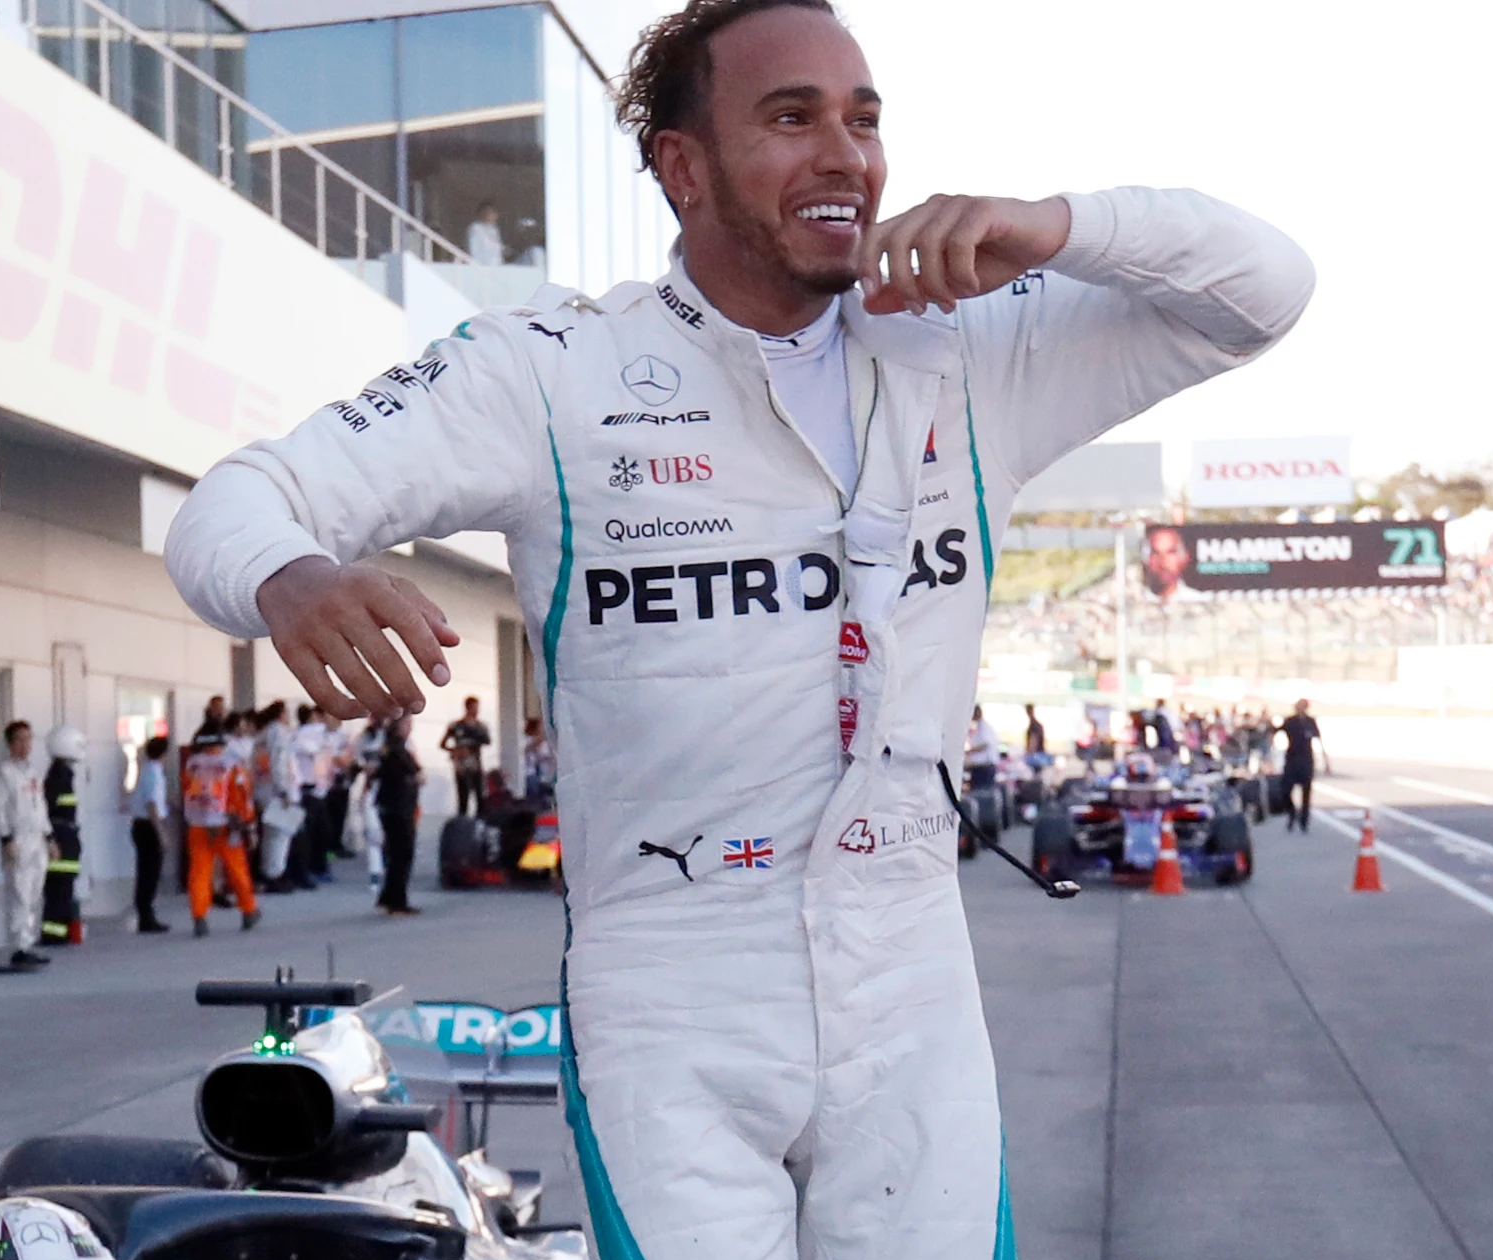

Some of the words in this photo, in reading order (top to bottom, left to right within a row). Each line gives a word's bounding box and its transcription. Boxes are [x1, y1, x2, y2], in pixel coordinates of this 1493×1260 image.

[656, 283, 706, 330] BOSE
[636, 411, 711, 425] AMG
[648, 453, 714, 485] UBS
[1202, 460, 1344, 481] HONDA
[605, 516, 734, 543] Qualcomm
[1196, 536, 1353, 562] HAMILTON
[1382, 527, 1444, 566] 71
